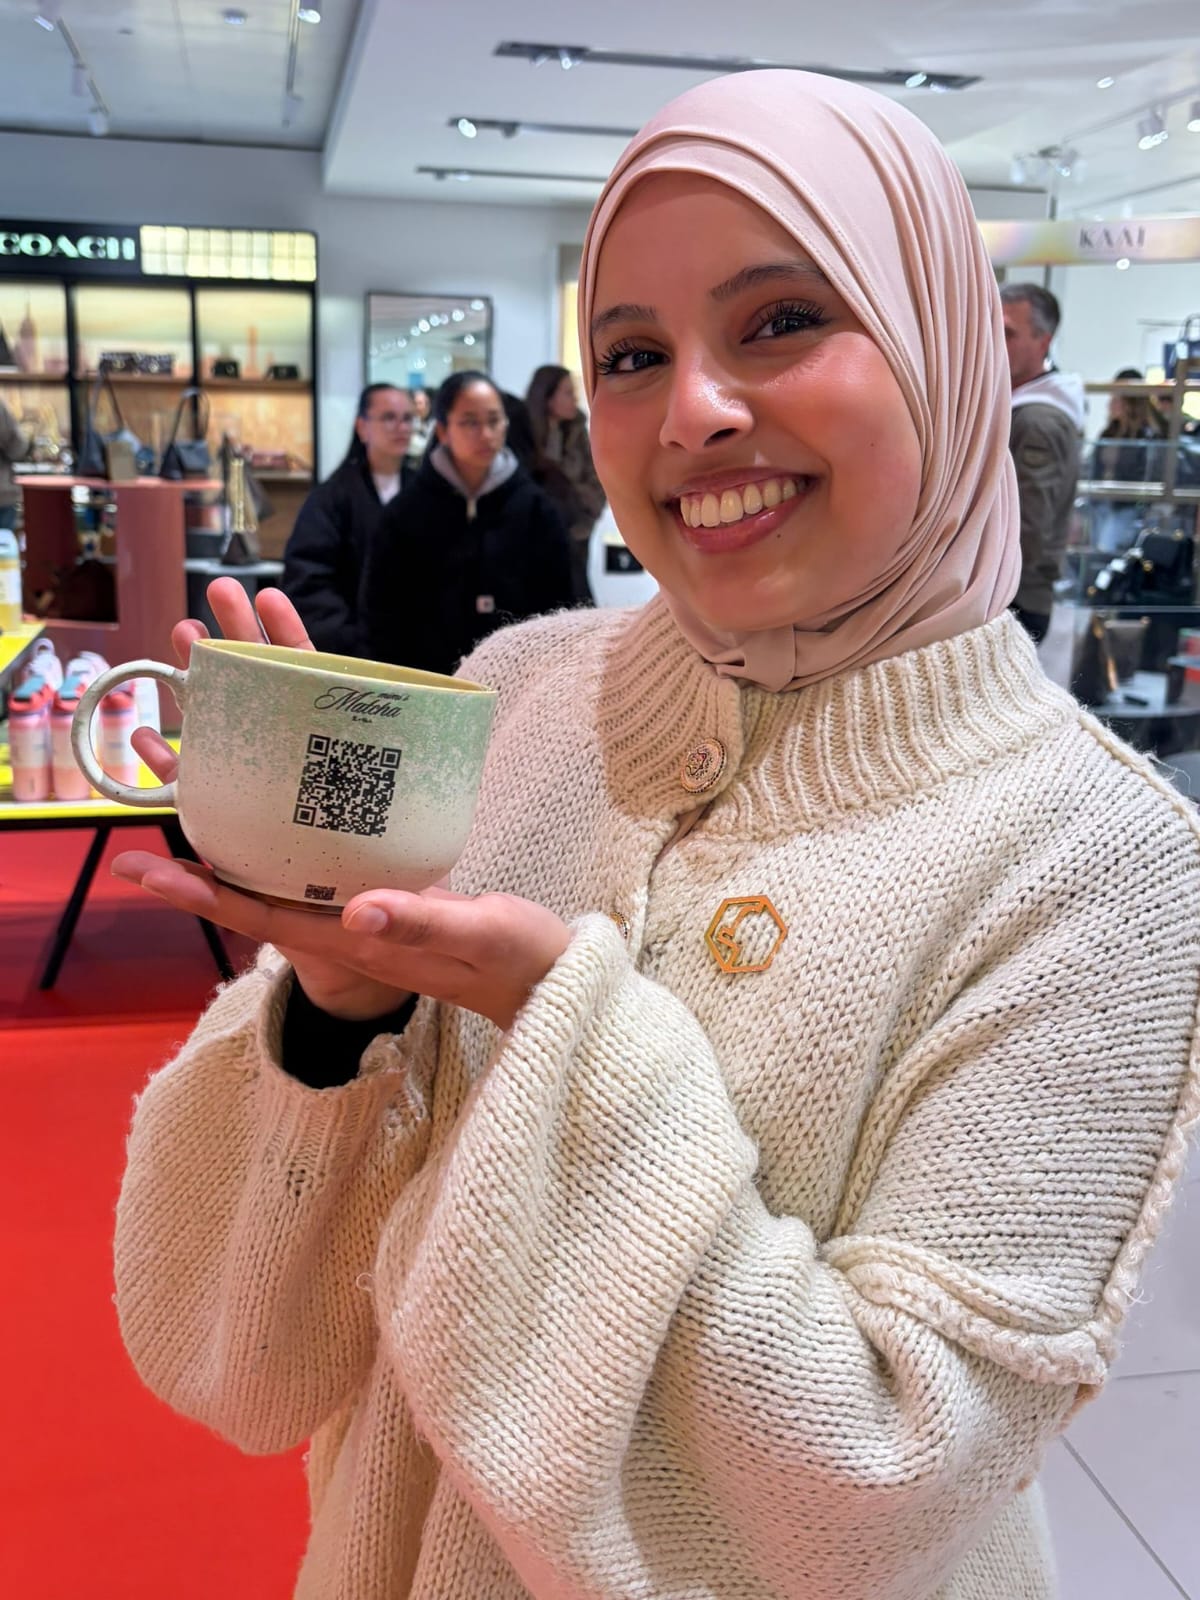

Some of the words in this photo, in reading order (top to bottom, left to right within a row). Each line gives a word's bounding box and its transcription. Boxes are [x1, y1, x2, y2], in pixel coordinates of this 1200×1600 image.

[0, 232, 136, 260] COACH
[1079, 225, 1147, 248] KAAI
[314, 686, 402, 718] Matcha
